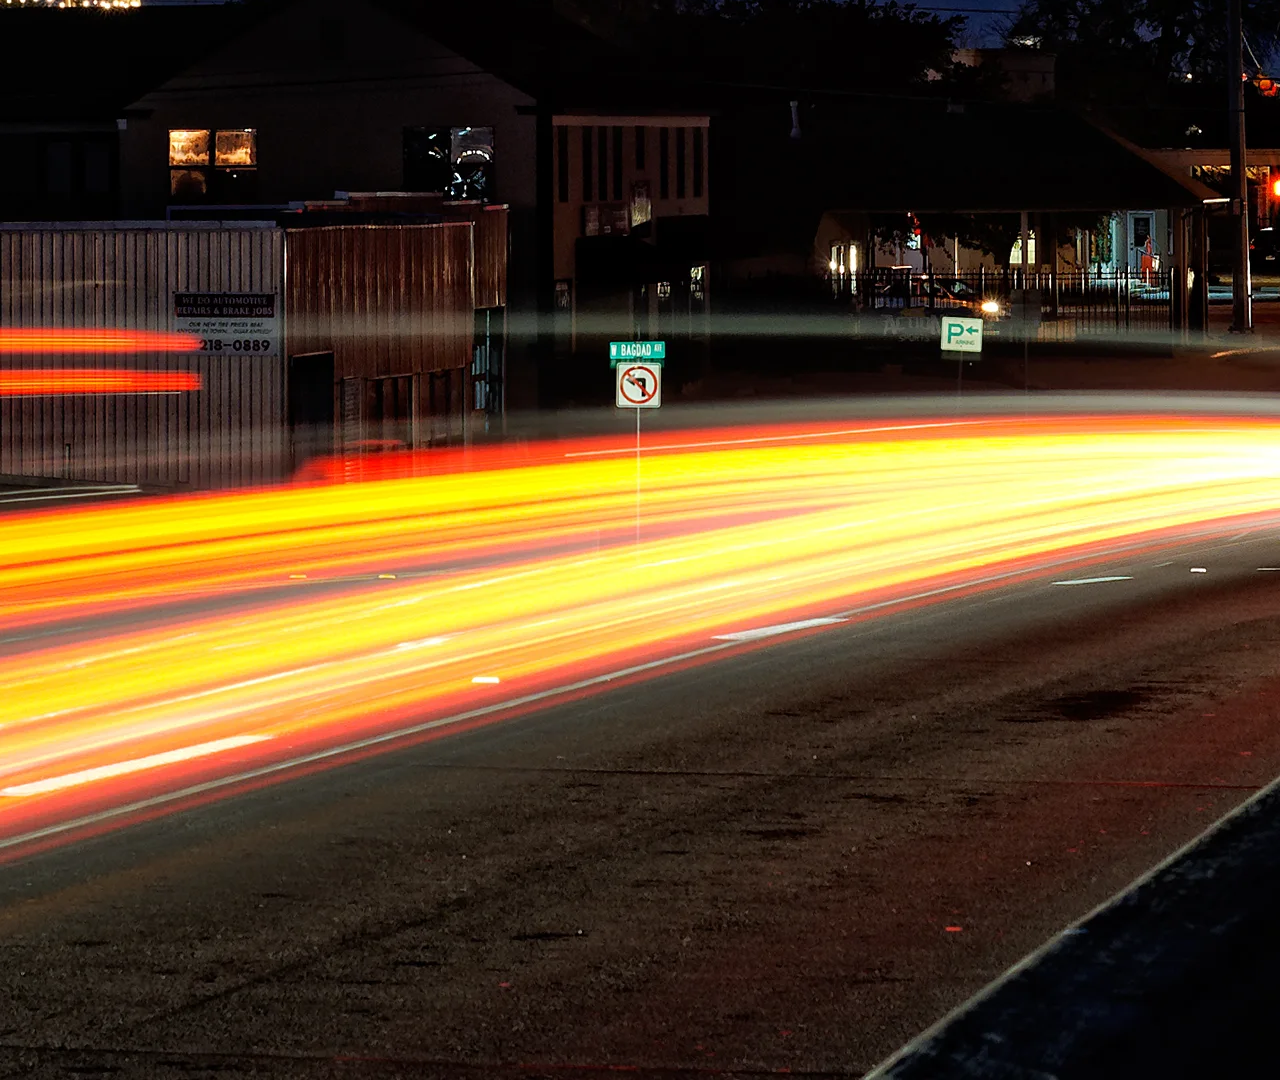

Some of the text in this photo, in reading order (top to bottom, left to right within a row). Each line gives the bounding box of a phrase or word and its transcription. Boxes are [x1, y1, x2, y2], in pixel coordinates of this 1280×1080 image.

[197, 297, 210, 305] DO
[213, 297, 268, 305] AUTOMOTIVE
[177, 307, 273, 316] REPAIRS & BRAKE JOBS
[199, 339, 270, 351] 218-0889
[611, 344, 662, 356] W BAGDAD AVE
